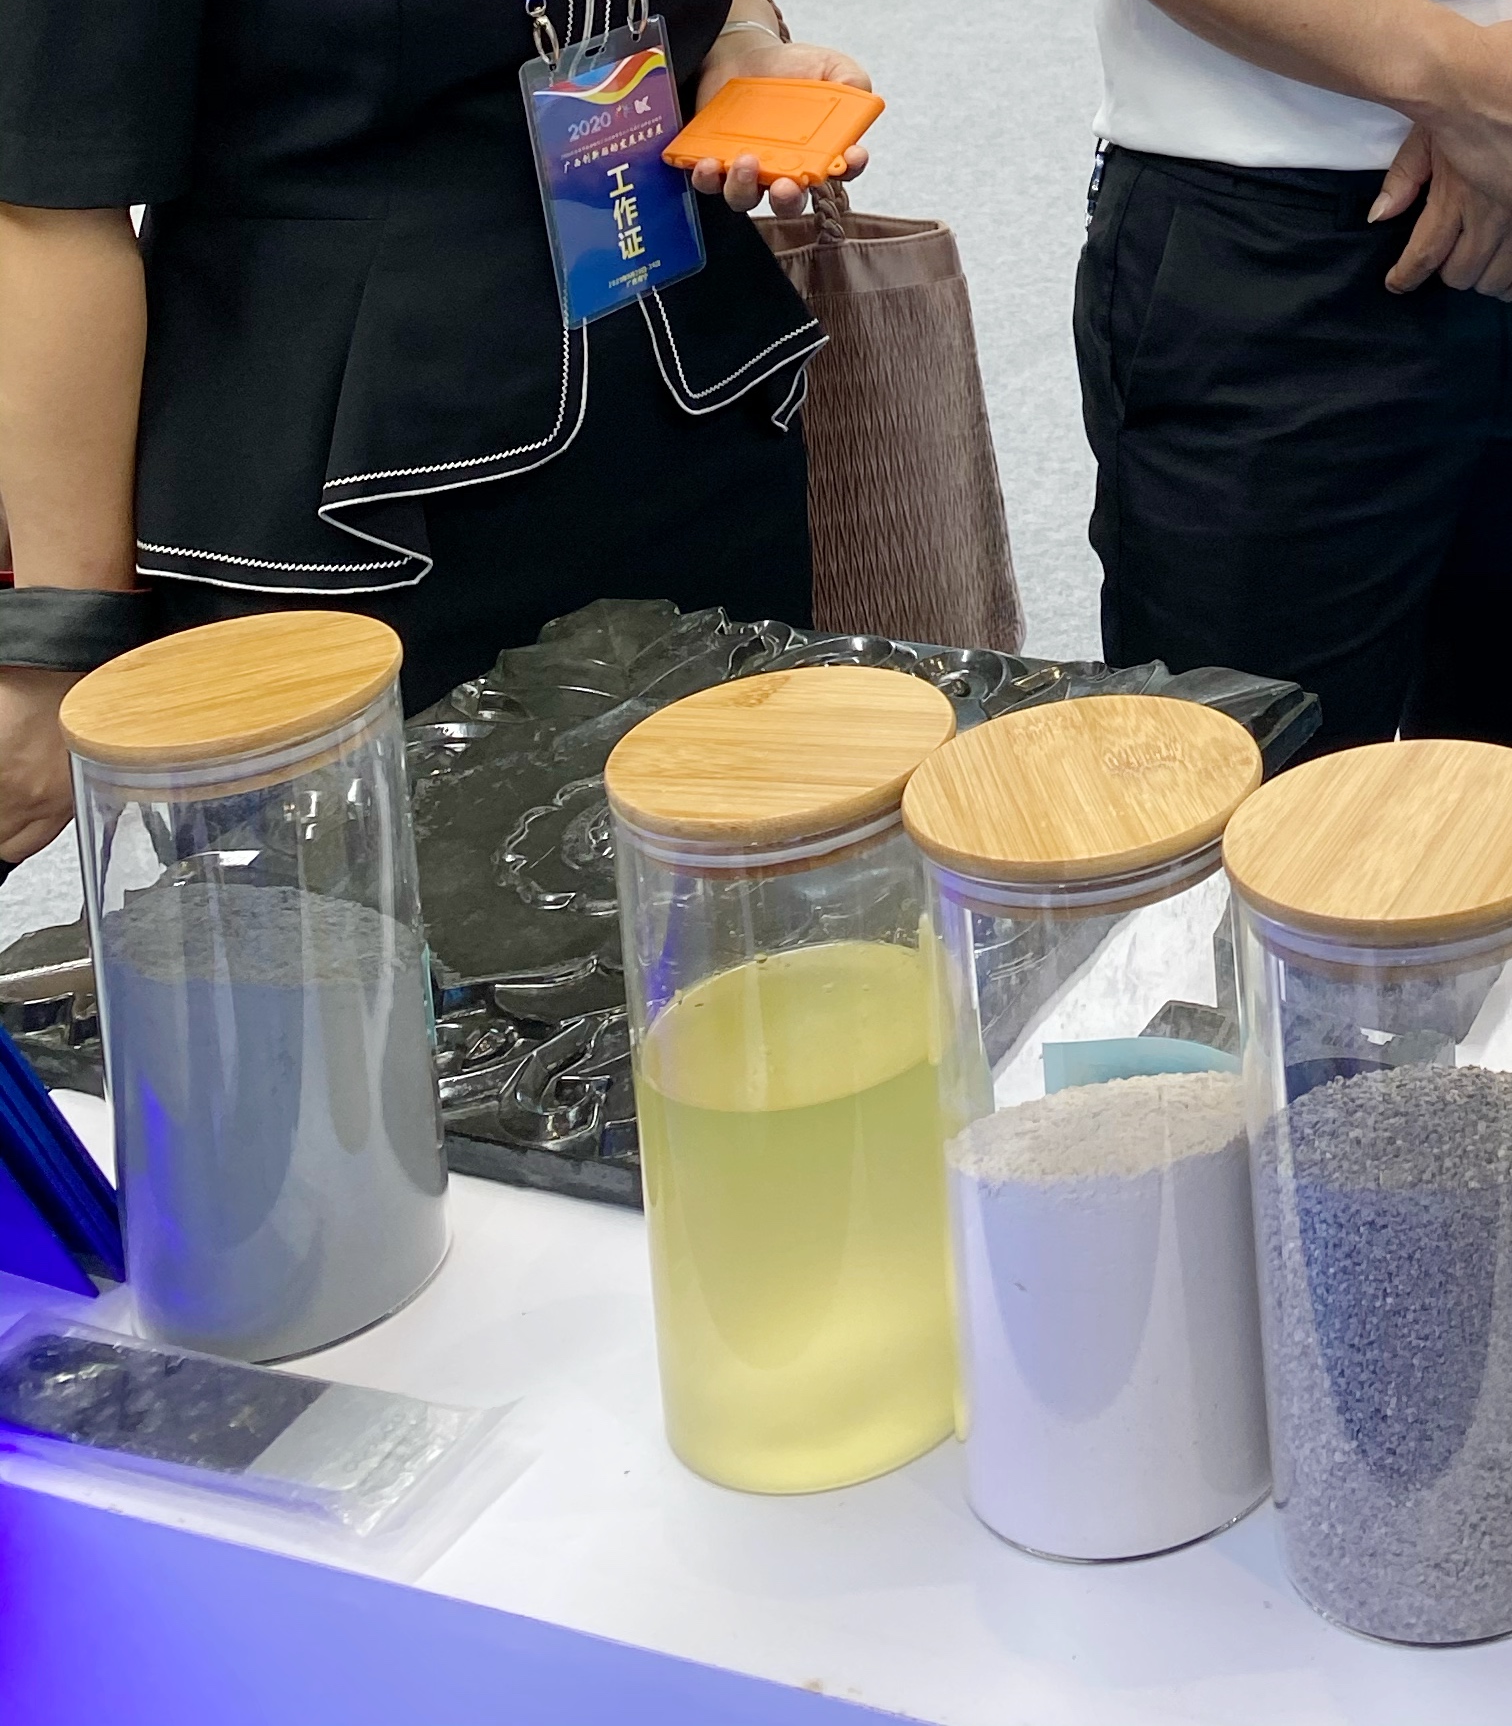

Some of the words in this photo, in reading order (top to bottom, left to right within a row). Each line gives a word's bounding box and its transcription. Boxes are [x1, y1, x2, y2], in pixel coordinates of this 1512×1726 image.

[567, 110, 612, 143] 2020
[606, 162, 646, 261] 工作证
